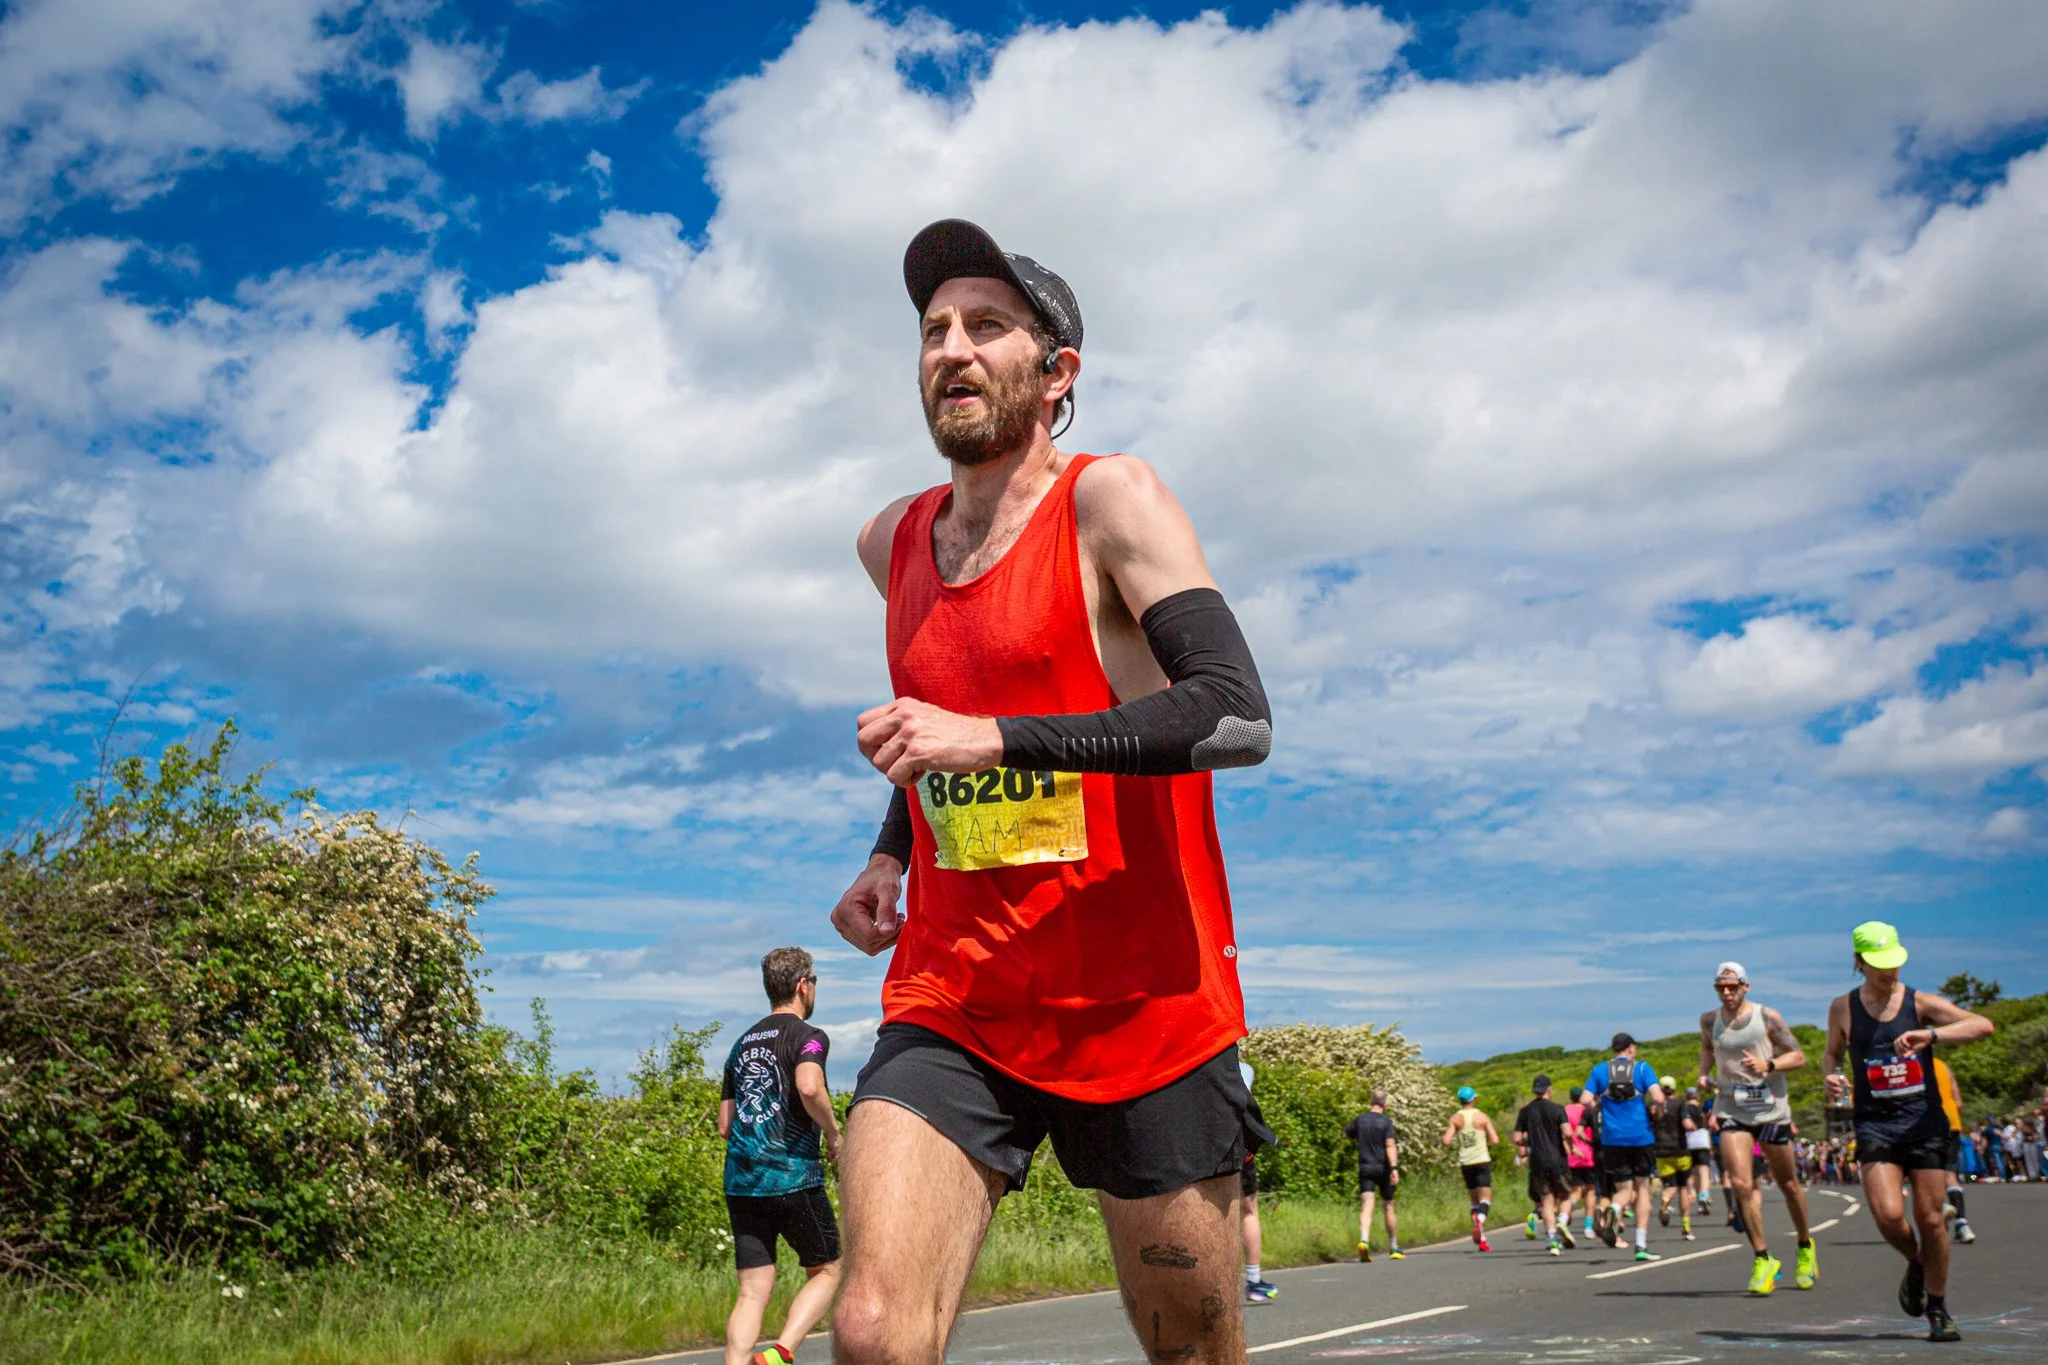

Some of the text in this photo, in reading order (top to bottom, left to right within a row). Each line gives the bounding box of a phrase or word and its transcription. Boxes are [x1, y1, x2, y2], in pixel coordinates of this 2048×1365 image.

[927, 767, 1056, 808] 86201
[734, 1047, 777, 1075] LIEBRES
[756, 1101, 781, 1123] CLUB
